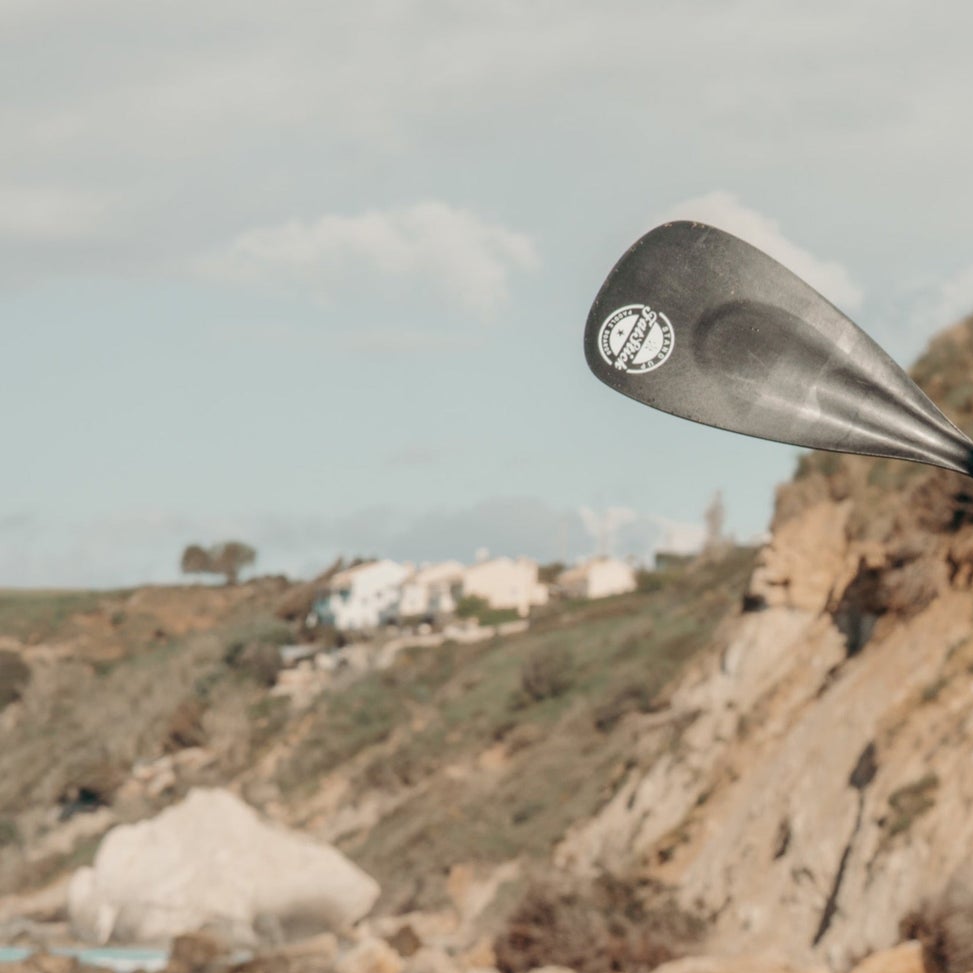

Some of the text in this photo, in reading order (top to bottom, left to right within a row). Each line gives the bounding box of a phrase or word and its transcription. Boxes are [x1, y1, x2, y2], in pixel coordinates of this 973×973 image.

[609, 309, 633, 328] PADDLE
[614, 305, 658, 371] FatStick
[640, 326, 671, 370] STAND UP
